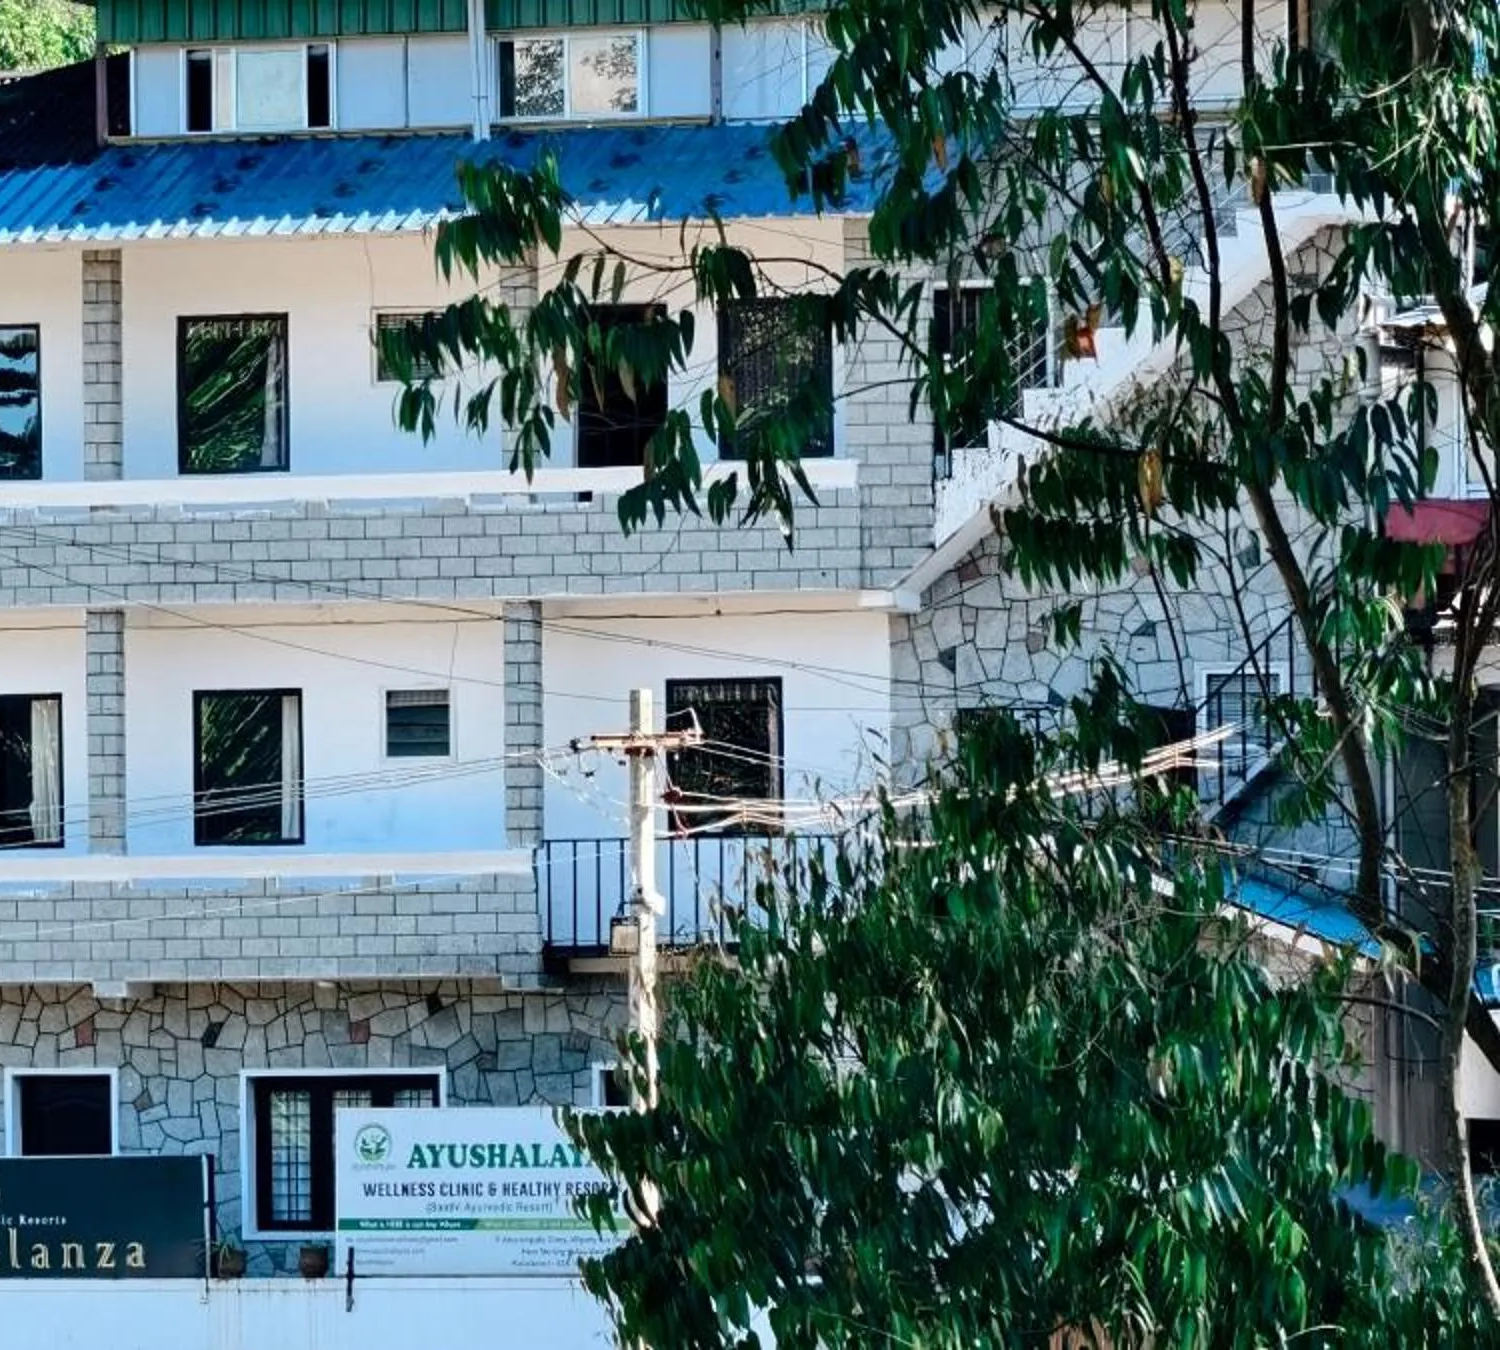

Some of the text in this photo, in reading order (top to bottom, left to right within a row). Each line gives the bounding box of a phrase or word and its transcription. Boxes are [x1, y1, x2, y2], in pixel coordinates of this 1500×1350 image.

[406, 1143, 596, 1169] AYUSHALAY
[363, 1182, 436, 1198] WELLNESS
[440, 1182, 483, 1198] CLINIC
[487, 1182, 498, 1198] &
[502, 1181, 561, 1197] HEALTHY
[18, 1213, 68, 1226] Resorts
